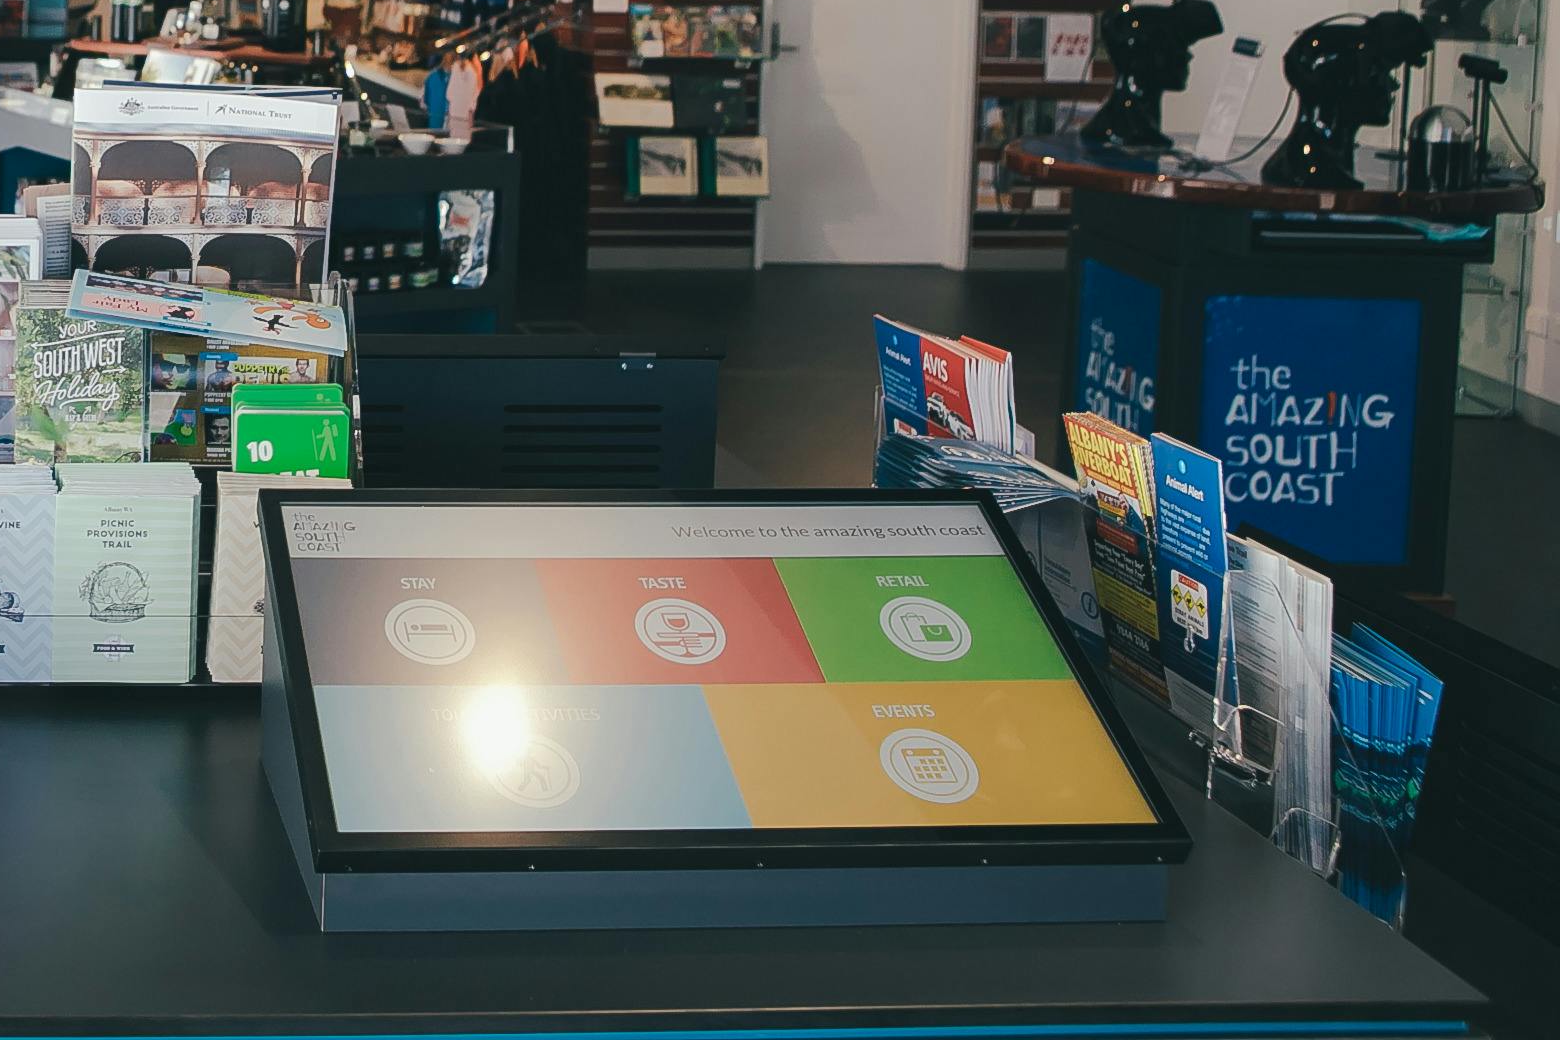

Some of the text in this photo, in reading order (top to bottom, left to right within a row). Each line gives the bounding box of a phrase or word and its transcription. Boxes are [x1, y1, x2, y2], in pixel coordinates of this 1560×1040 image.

[228, 107, 293, 120] NATIONAL TRUST
[59, 320, 97, 338] YOUR
[33, 337, 126, 379] SOUTH WEST
[923, 351, 949, 383] AVIS
[1230, 354, 1291, 390] the
[33, 369, 120, 411] Holiday
[246, 440, 273, 463] 10
[1068, 421, 1129, 467] ALBANY'S
[1226, 431, 1357, 470] SOUTH
[1072, 444, 1134, 488] RIVERBOAT
[1165, 474, 1205, 502] Animal Alert
[1224, 471, 1345, 506] COAST
[100, 519, 135, 527] PICNIC
[293, 512, 315, 521] the
[86, 530, 149, 538] PROVISIONS
[295, 532, 345, 542] SOUTH
[672, 524, 986, 540] Welcome to the amazing south coast
[102, 540, 132, 549] TRAIL
[297, 542, 342, 552] COAST
[400, 577, 436, 589] STAY
[638, 576, 687, 589] TASTE
[875, 575, 930, 588] RETAIL
[871, 703, 935, 719] EVENTS
